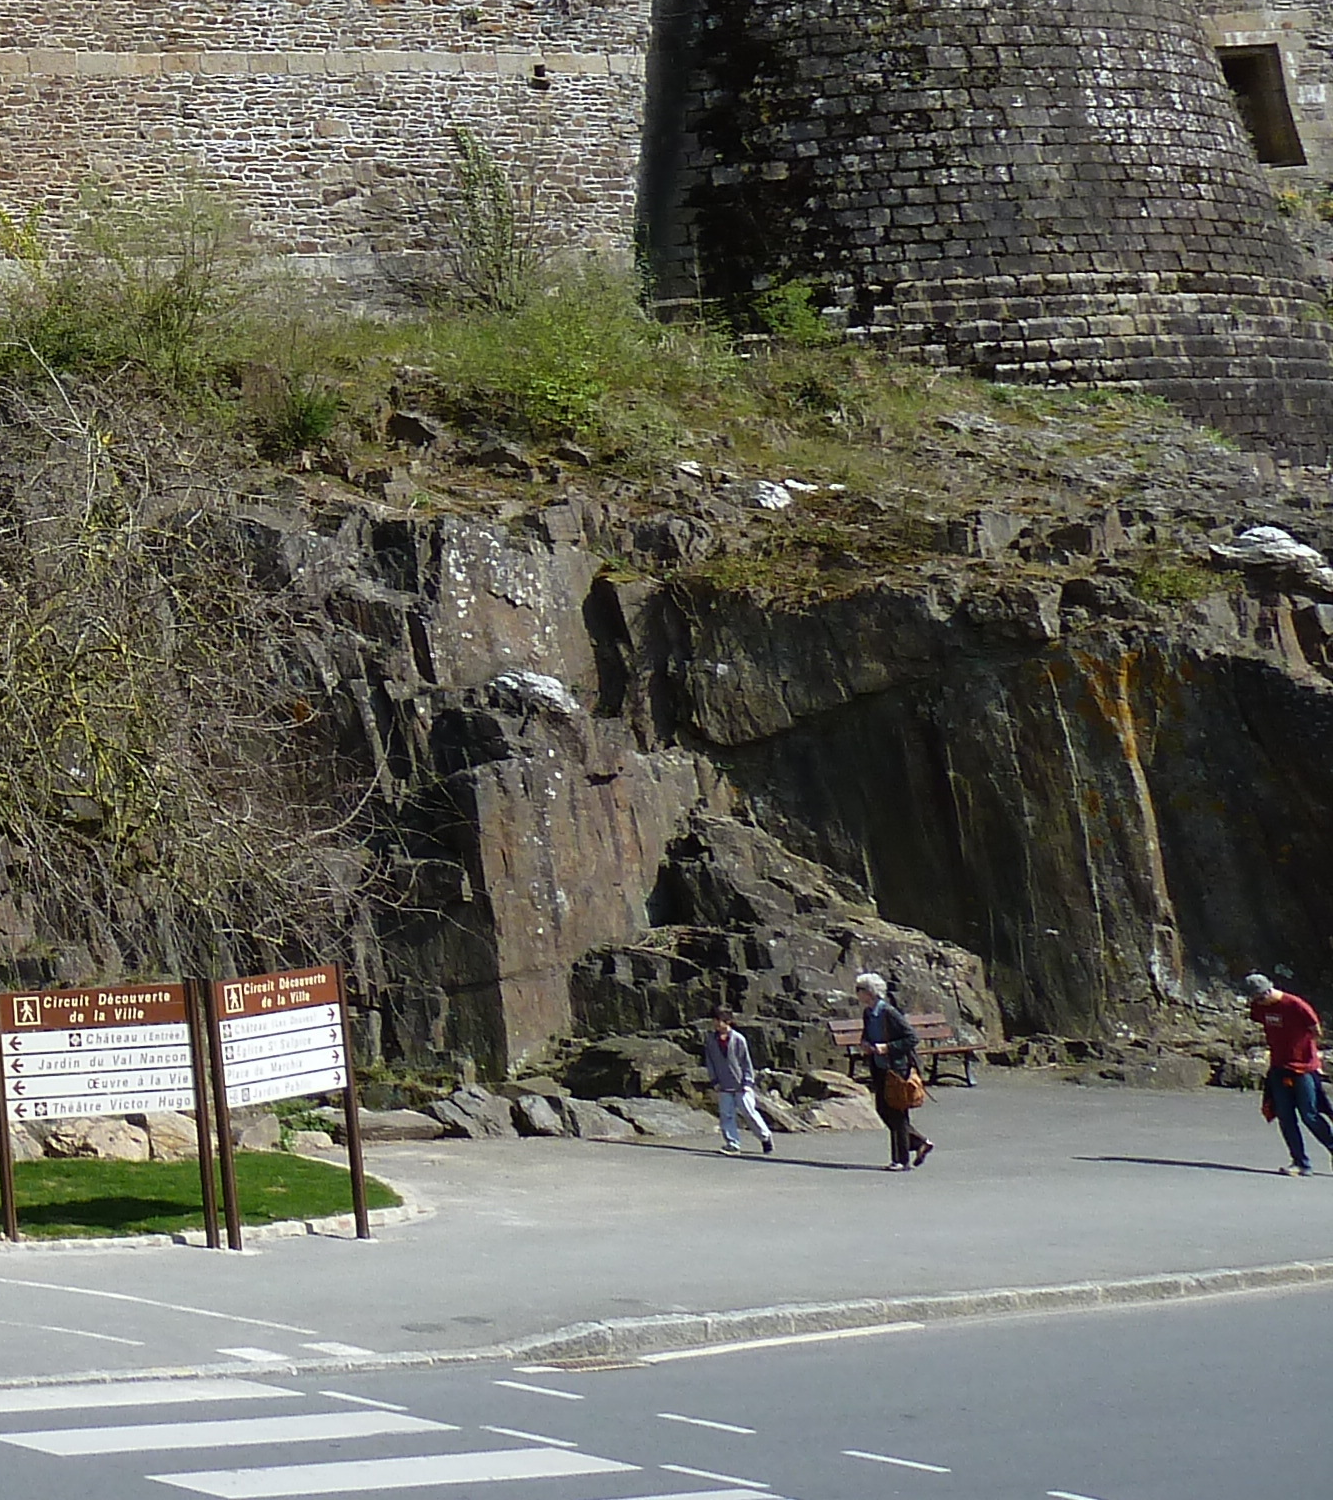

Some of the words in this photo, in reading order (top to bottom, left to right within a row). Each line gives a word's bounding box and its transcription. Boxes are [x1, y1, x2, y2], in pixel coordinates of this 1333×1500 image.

[243, 980, 275, 995] Circuit
[279, 973, 326, 990] Découverte
[43, 994, 90, 1009] Circuit
[98, 991, 171, 1006] Découverte
[261, 996, 272, 1009] de
[277, 994, 286, 1006] la
[289, 991, 310, 1004] Ville
[69, 1010, 84, 1023] de
[94, 1009, 106, 1022] la
[114, 1007, 145, 1021] Ville
[86, 1032, 138, 1045] Château
[143, 1029, 185, 1042] (Entrée)
[38, 1058, 81, 1071] Jardin
[89, 1056, 104, 1068] du
[112, 1054, 133, 1066] Val
[140, 1052, 187, 1066] Nançon
[87, 1078, 129, 1090] Œuvre
[137, 1074, 144, 1086] à
[150, 1074, 161, 1086] la
[169, 1073, 189, 1085] Vie
[53, 1101, 101, 1114] Théâtre
[110, 1099, 150, 1111] Victor
[158, 1096, 191, 1109] Hugo
